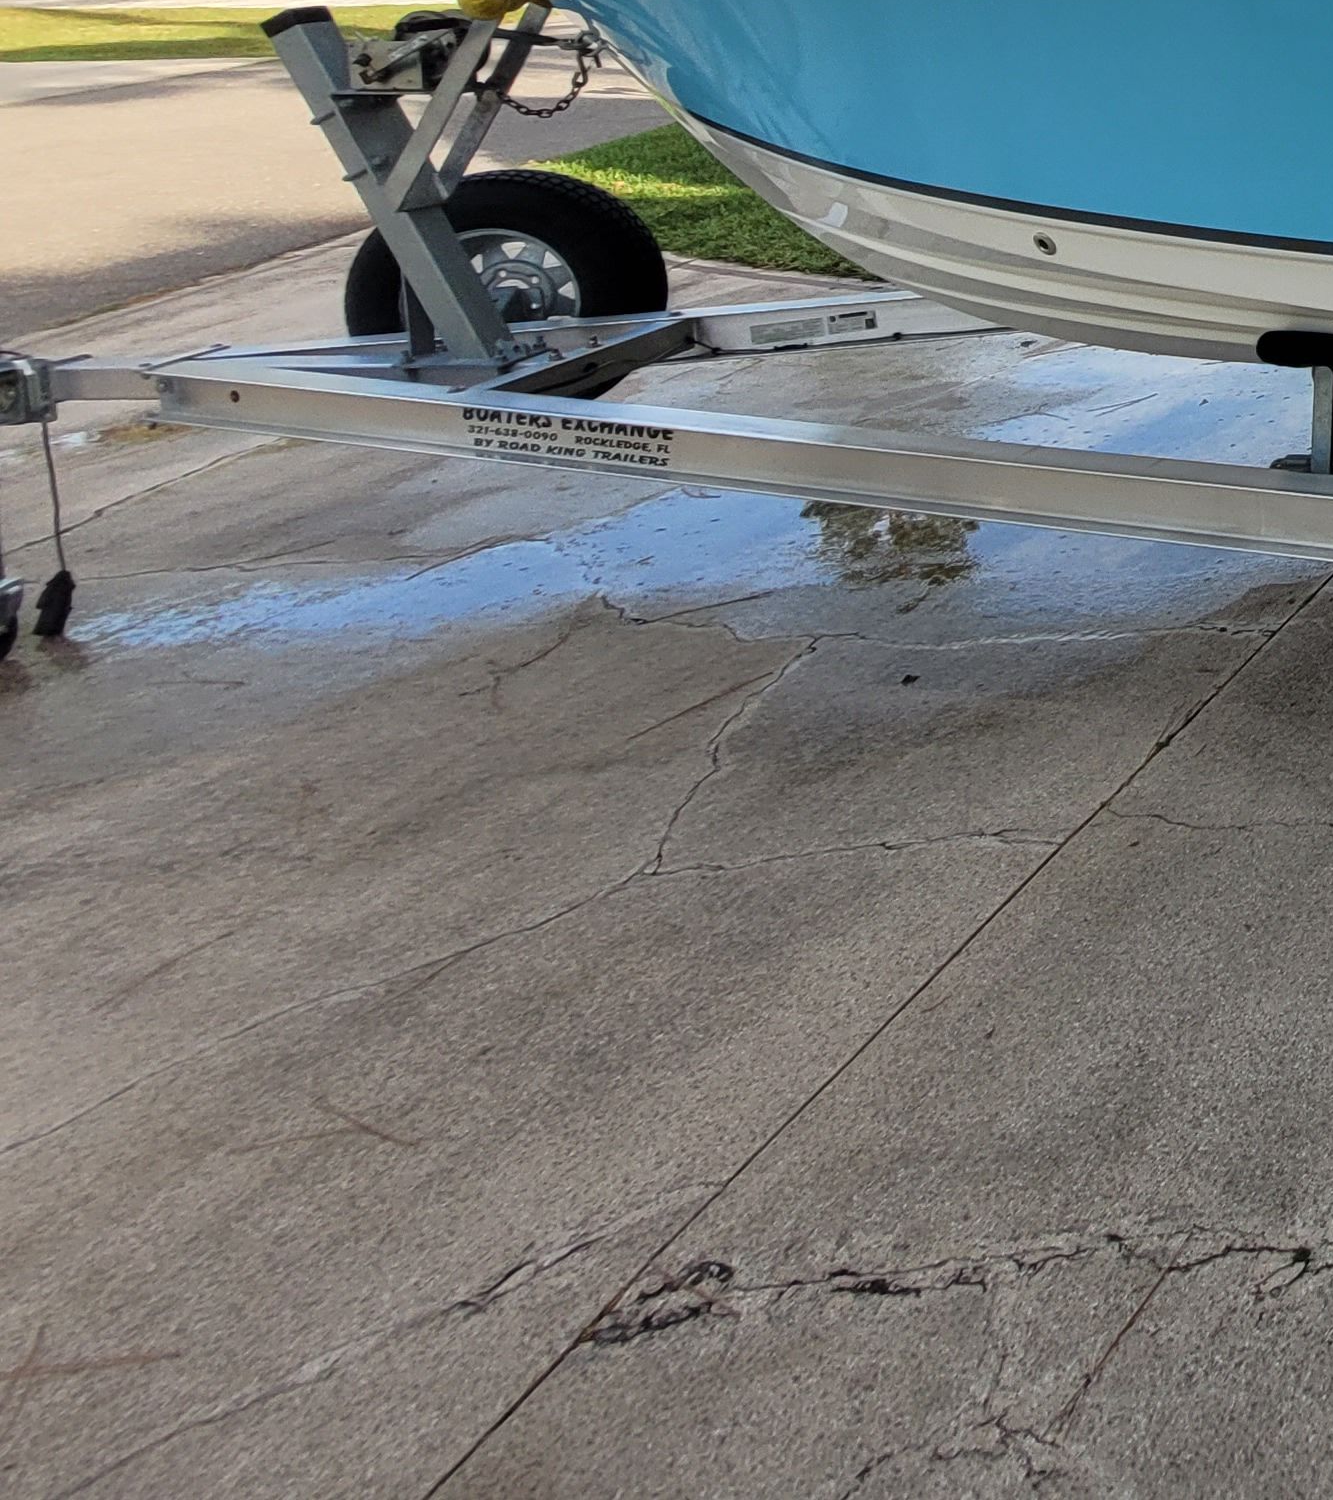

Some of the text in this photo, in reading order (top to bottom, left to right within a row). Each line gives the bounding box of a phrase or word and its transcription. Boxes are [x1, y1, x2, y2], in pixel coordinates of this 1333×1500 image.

[467, 424, 671, 453] 321-638-0090 ROCKLEDGE, FL
[474, 437, 670, 467] BY ROAD KING TRAILERS
